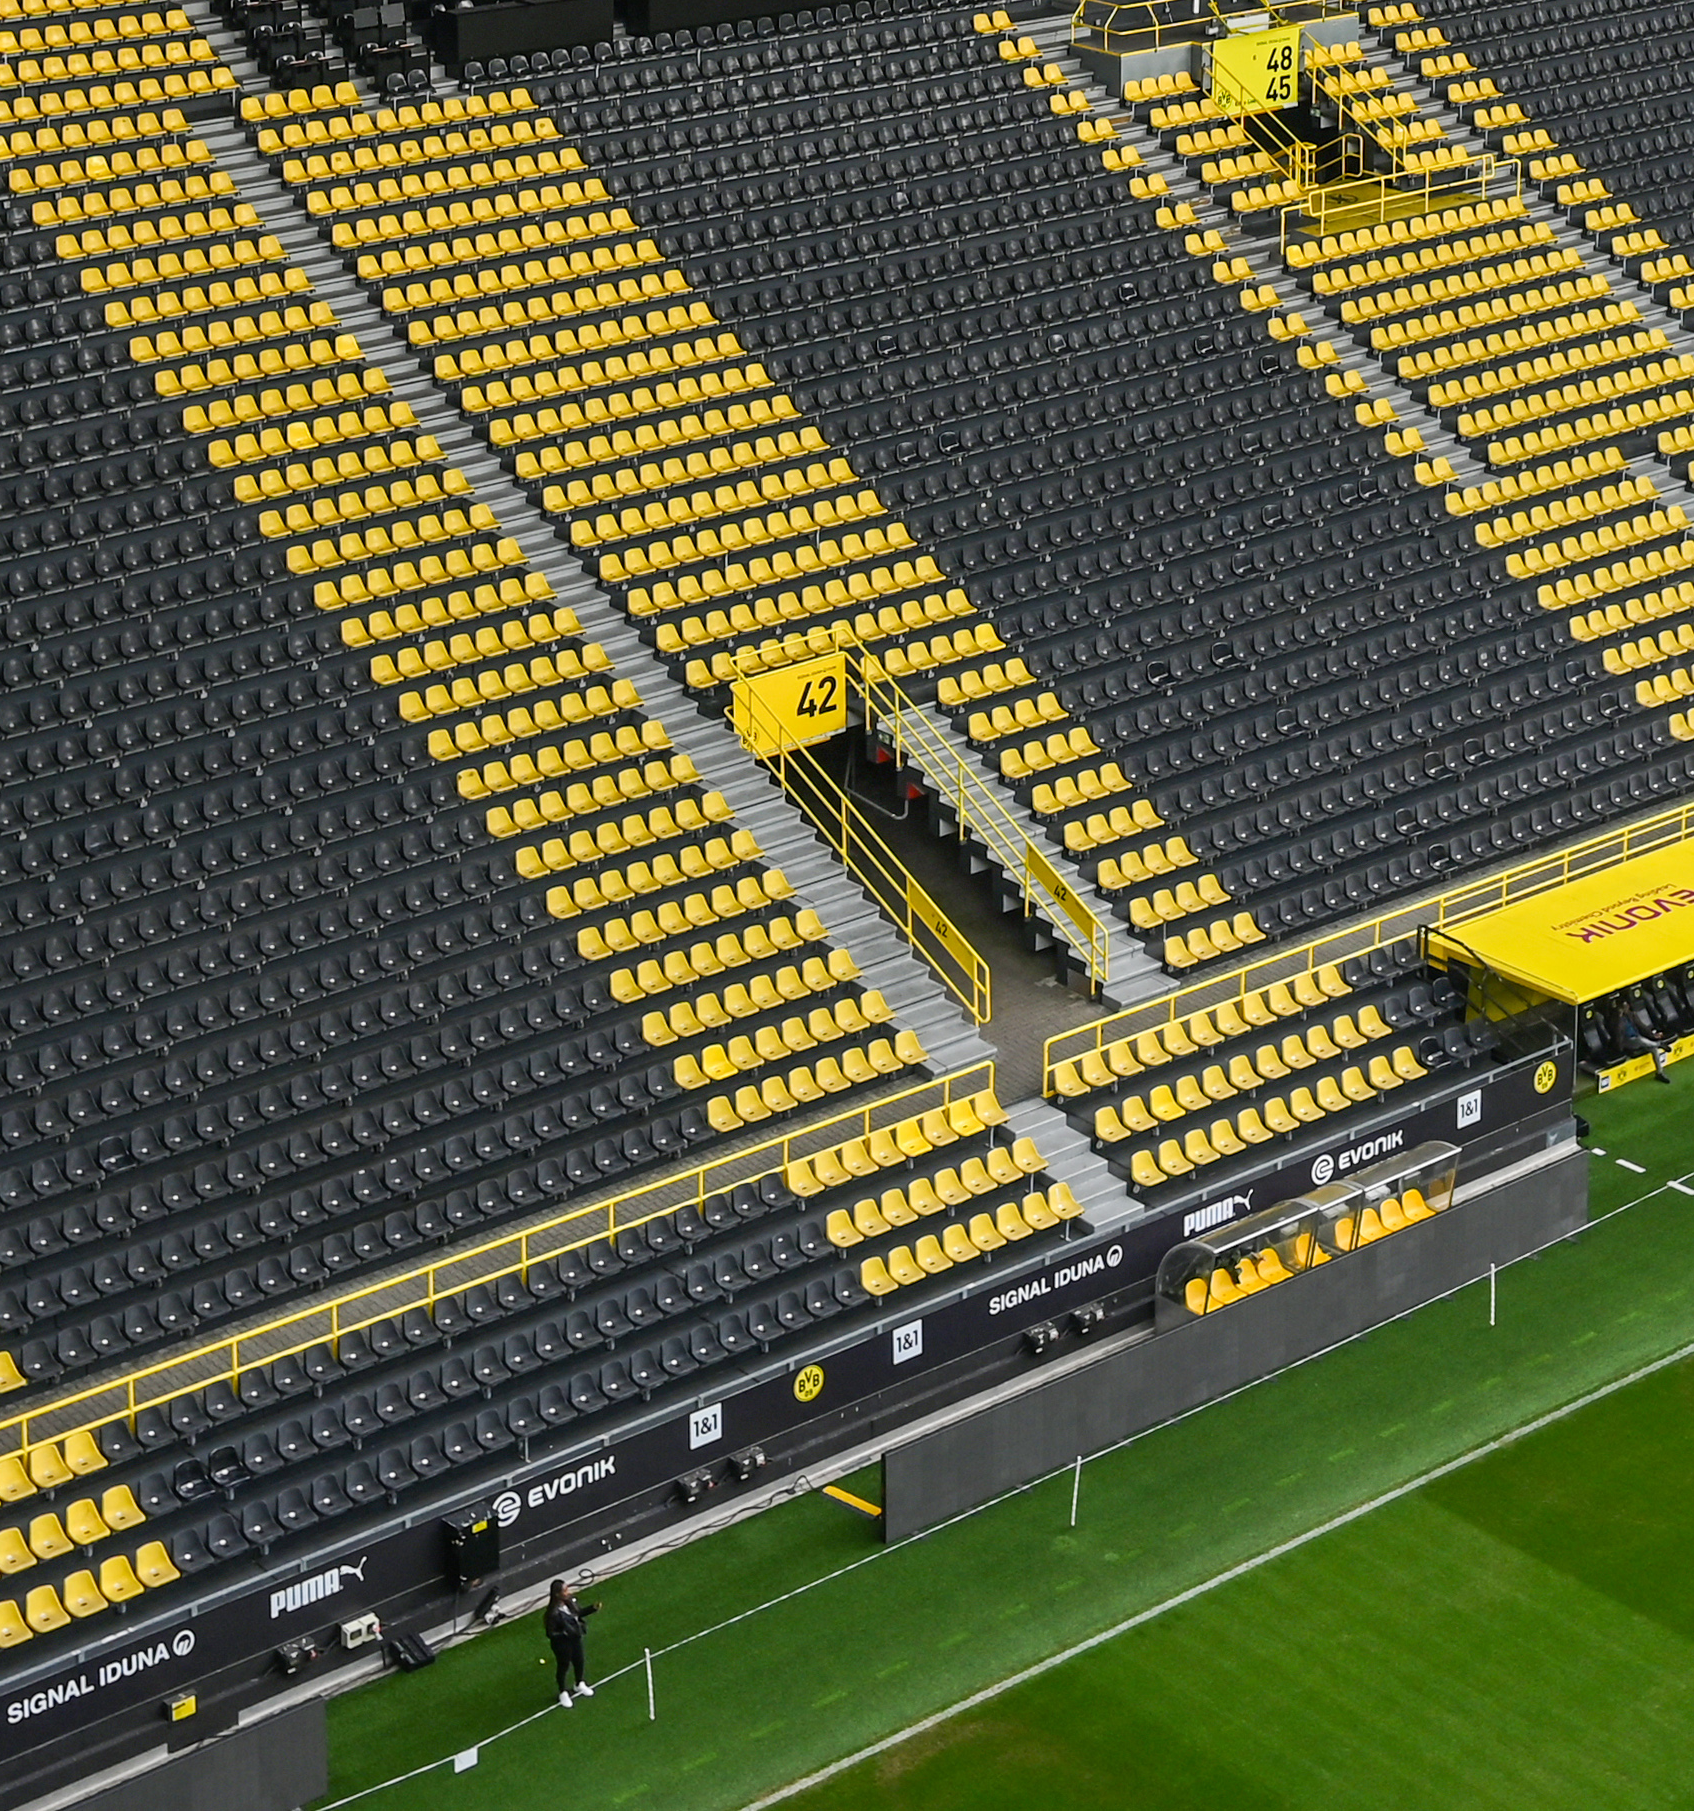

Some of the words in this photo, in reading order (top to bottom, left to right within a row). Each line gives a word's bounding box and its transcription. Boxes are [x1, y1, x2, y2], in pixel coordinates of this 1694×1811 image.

[1267, 46, 1292, 72] 48
[1266, 75, 1291, 101] 45
[797, 676, 837, 717] 42
[1054, 885, 1067, 901] 42
[935, 921, 948, 938] 42
[1537, 1061, 1554, 1084] BVB
[1460, 1099, 1479, 1120] 1&1
[1338, 1130, 1404, 1171] EVONIK
[1184, 1198, 1235, 1237] PUMA
[989, 1278, 1052, 1316] SIGNAL
[1054, 1255, 1105, 1292] IDUNA
[897, 1331, 919, 1351] 1&1
[798, 1369, 820, 1394] BVB
[694, 1414, 717, 1438] 1&1
[528, 1455, 617, 1508] EVONIK
[270, 1568, 340, 1619] PUMA
[7, 1675, 95, 1724] SIGNAL
[98, 1642, 169, 1687] IDUNA
